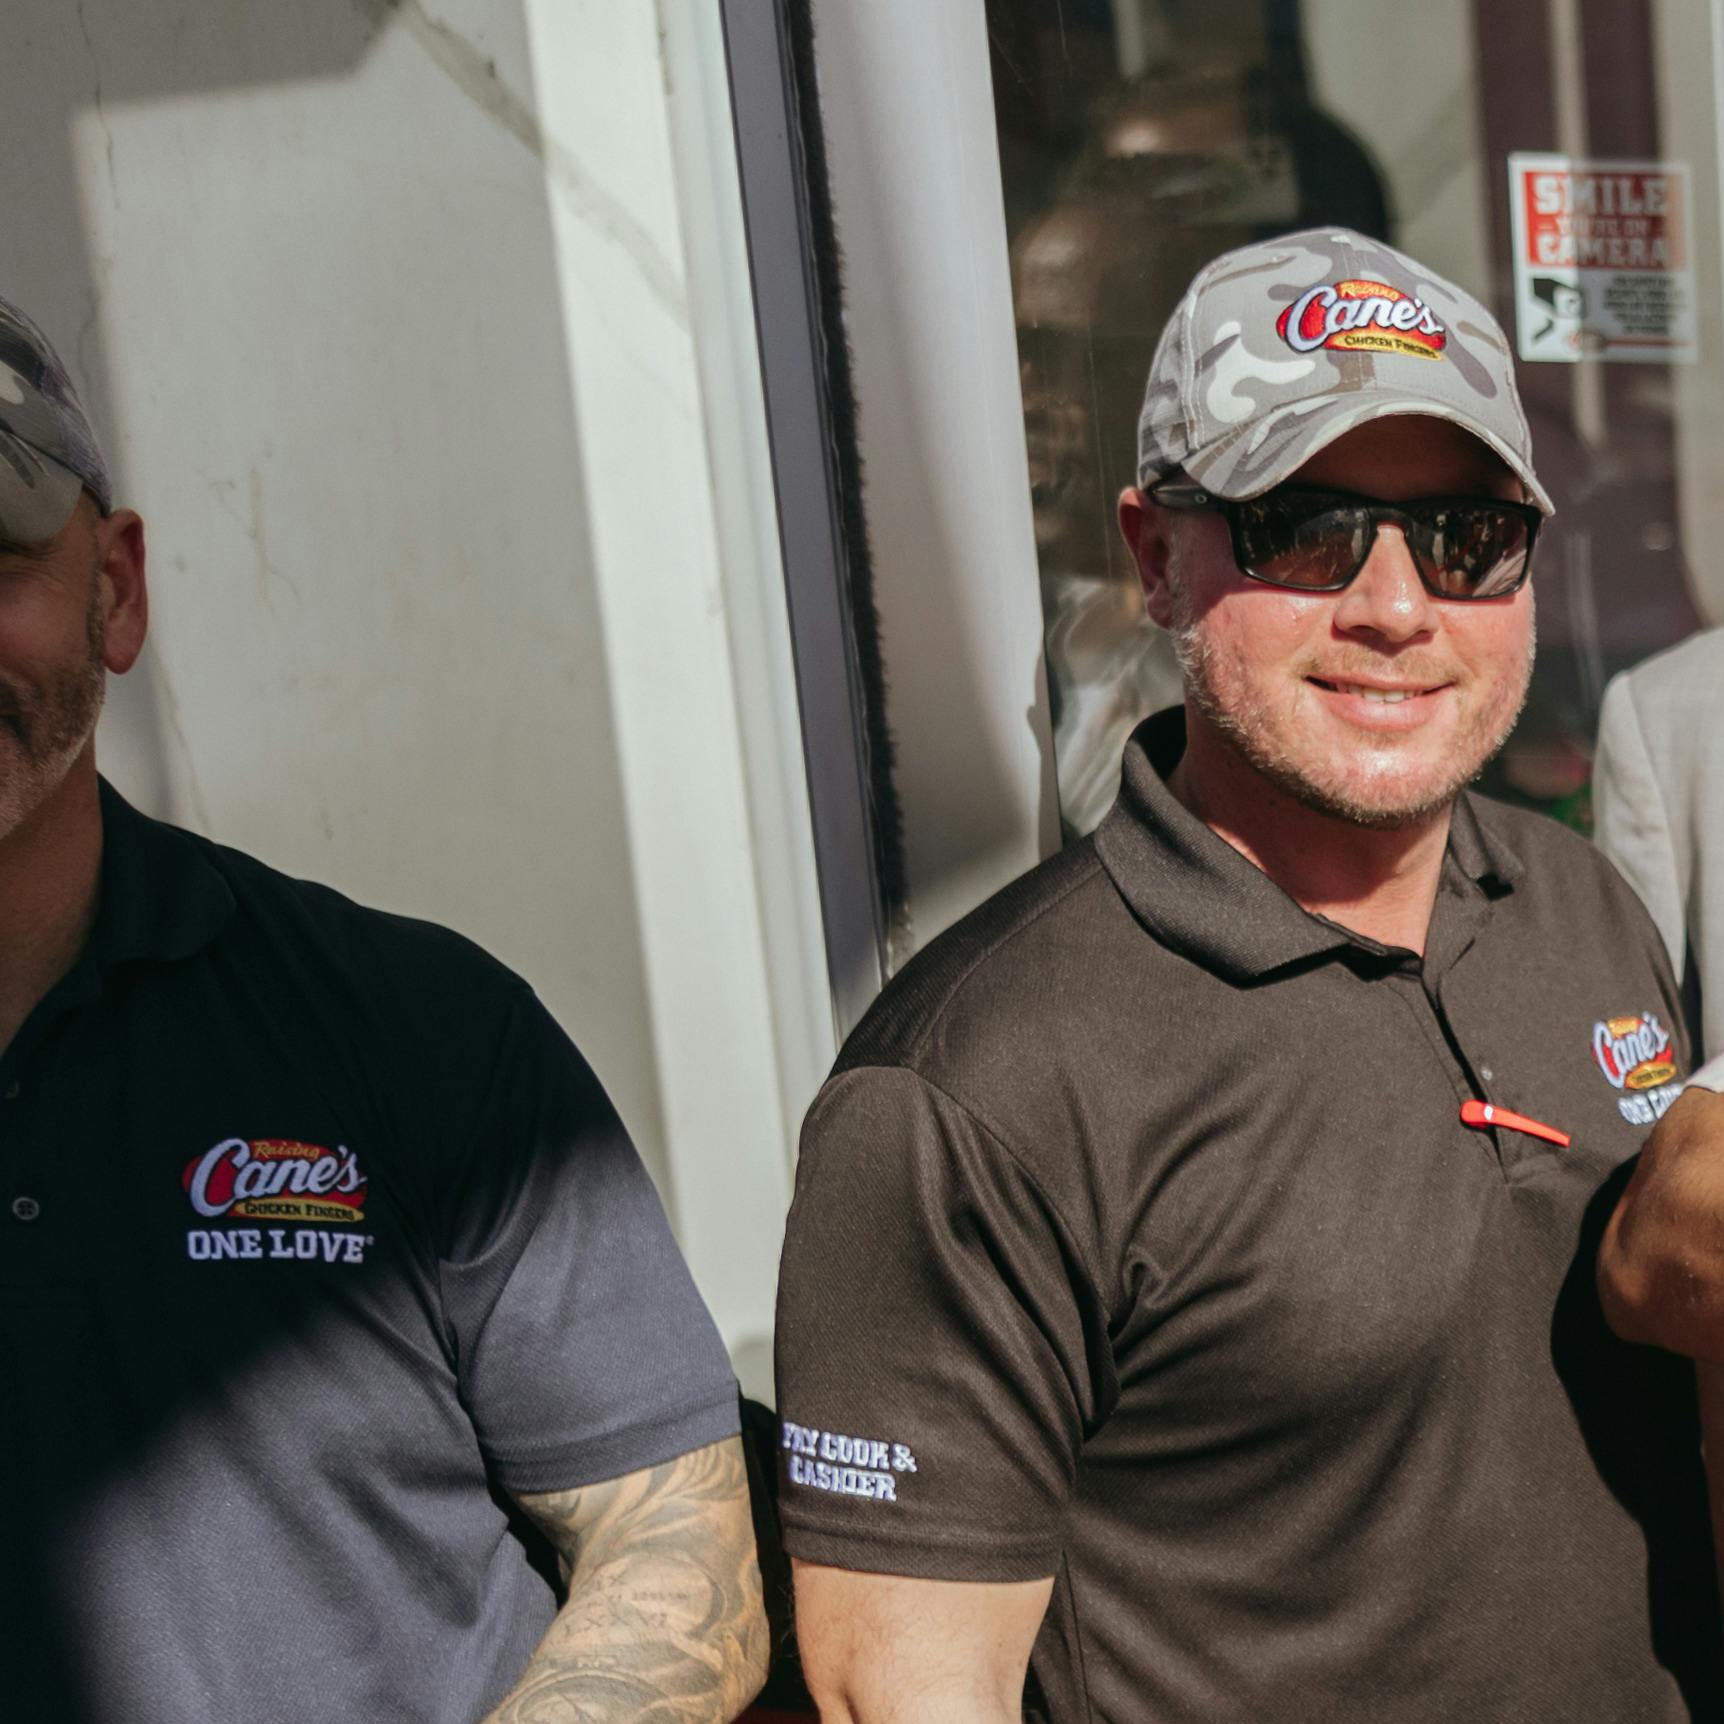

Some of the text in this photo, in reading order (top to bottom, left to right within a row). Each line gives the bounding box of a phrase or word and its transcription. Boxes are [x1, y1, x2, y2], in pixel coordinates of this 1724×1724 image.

[1533, 176, 1668, 216] SMILE
[1536, 232, 1669, 266] CAMERA
[1286, 285, 1445, 352] Cane's
[190, 1138, 368, 1218] Cane's
[187, 1229, 263, 1260] ONE
[820, 1431, 890, 1470] COOK
[892, 1443, 917, 1473] &
[790, 1455, 897, 1501] CASHIER
